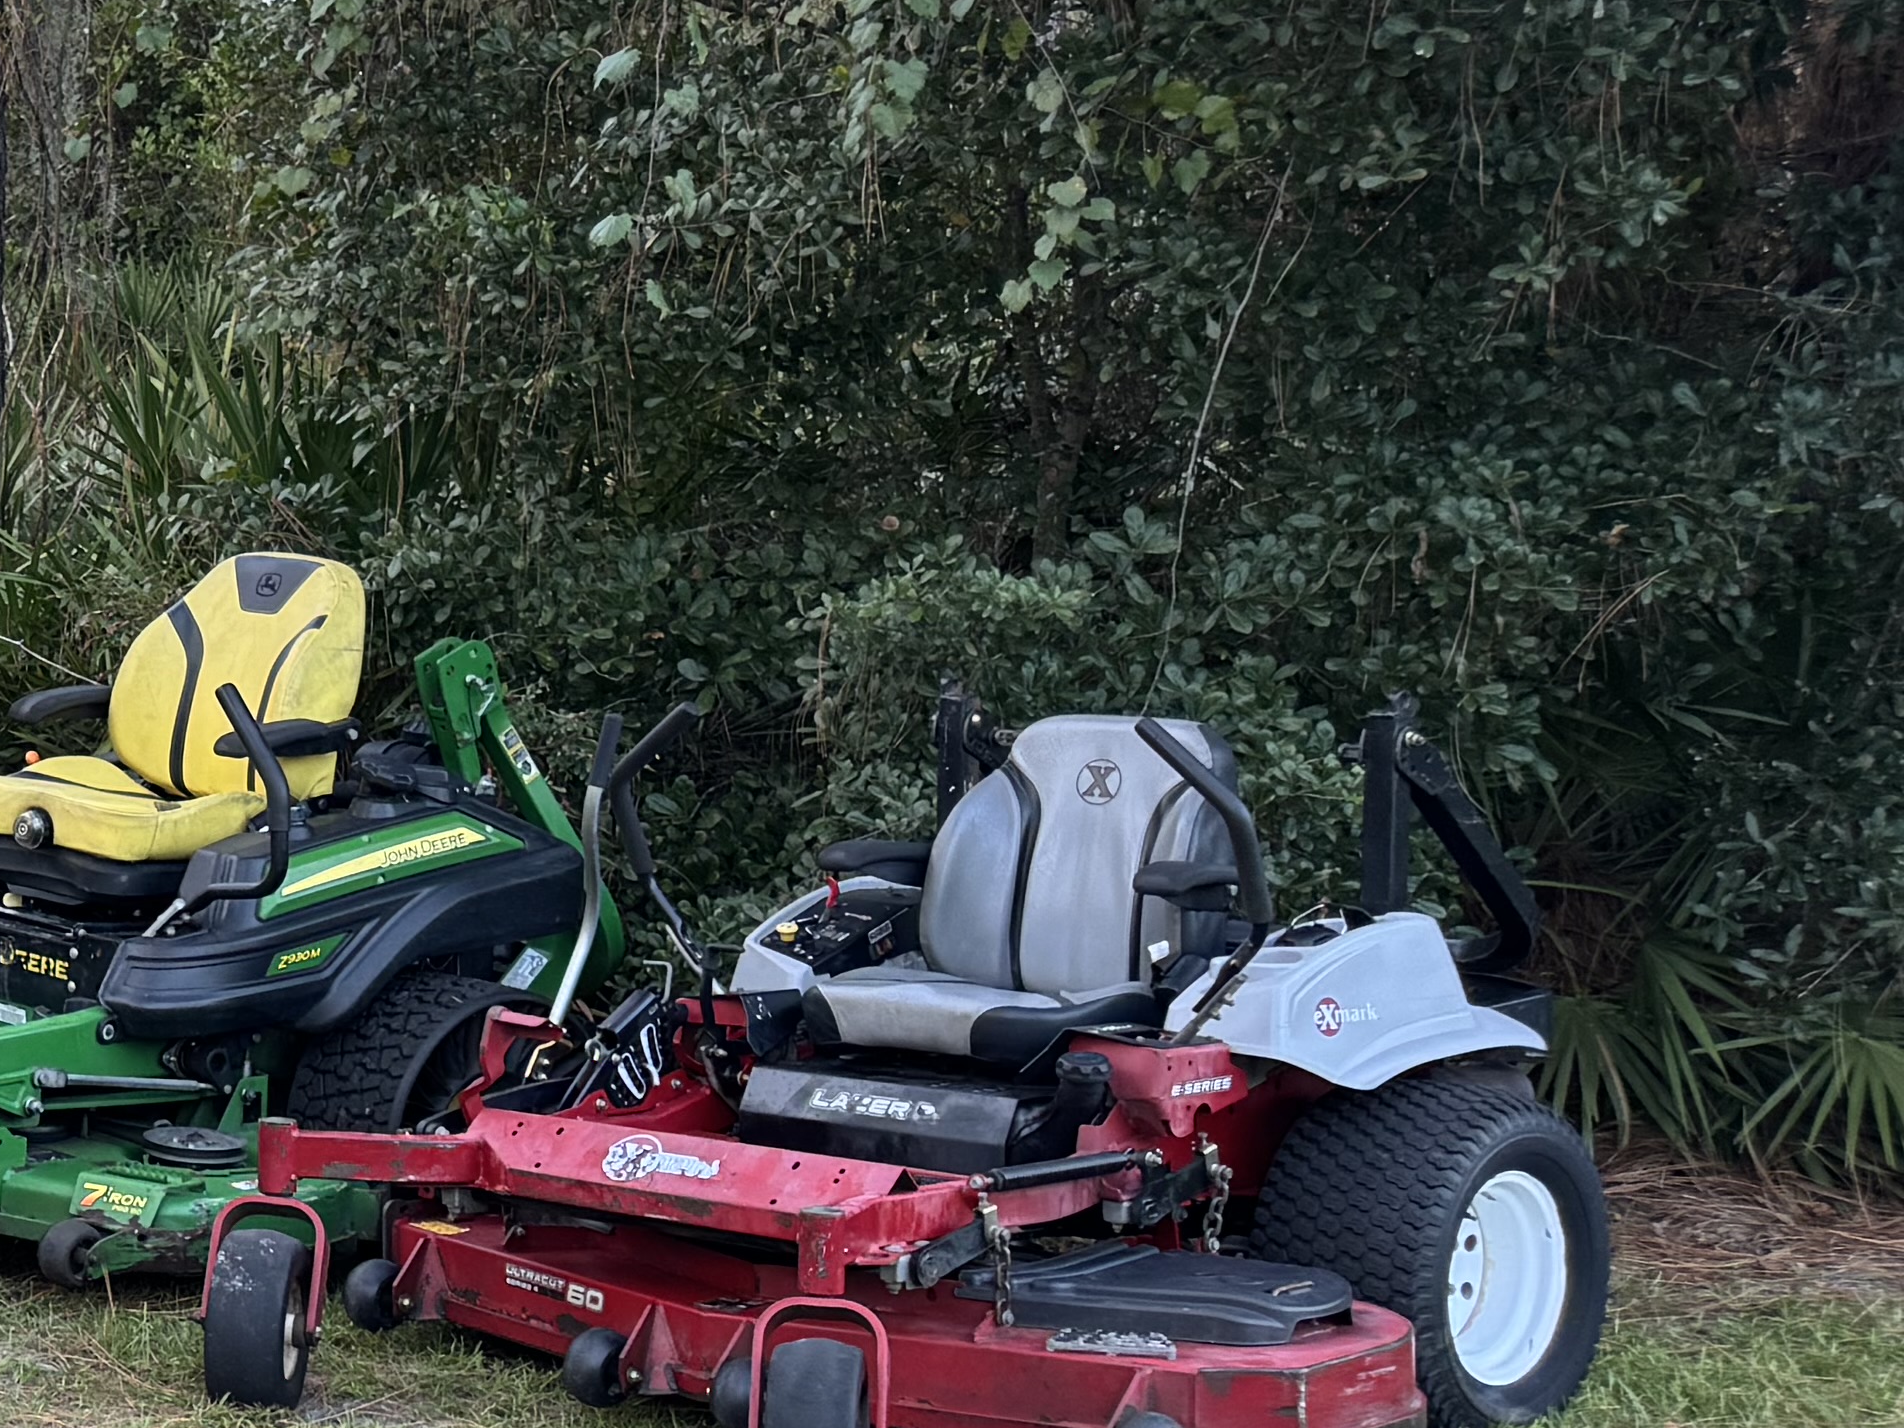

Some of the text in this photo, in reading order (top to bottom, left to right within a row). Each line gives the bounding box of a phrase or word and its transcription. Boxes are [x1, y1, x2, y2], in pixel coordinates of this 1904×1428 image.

[381, 832, 467, 866] JOHN DEERE
[1171, 1076, 1233, 1097] E-SERIES
[567, 1283, 604, 1313] 60
